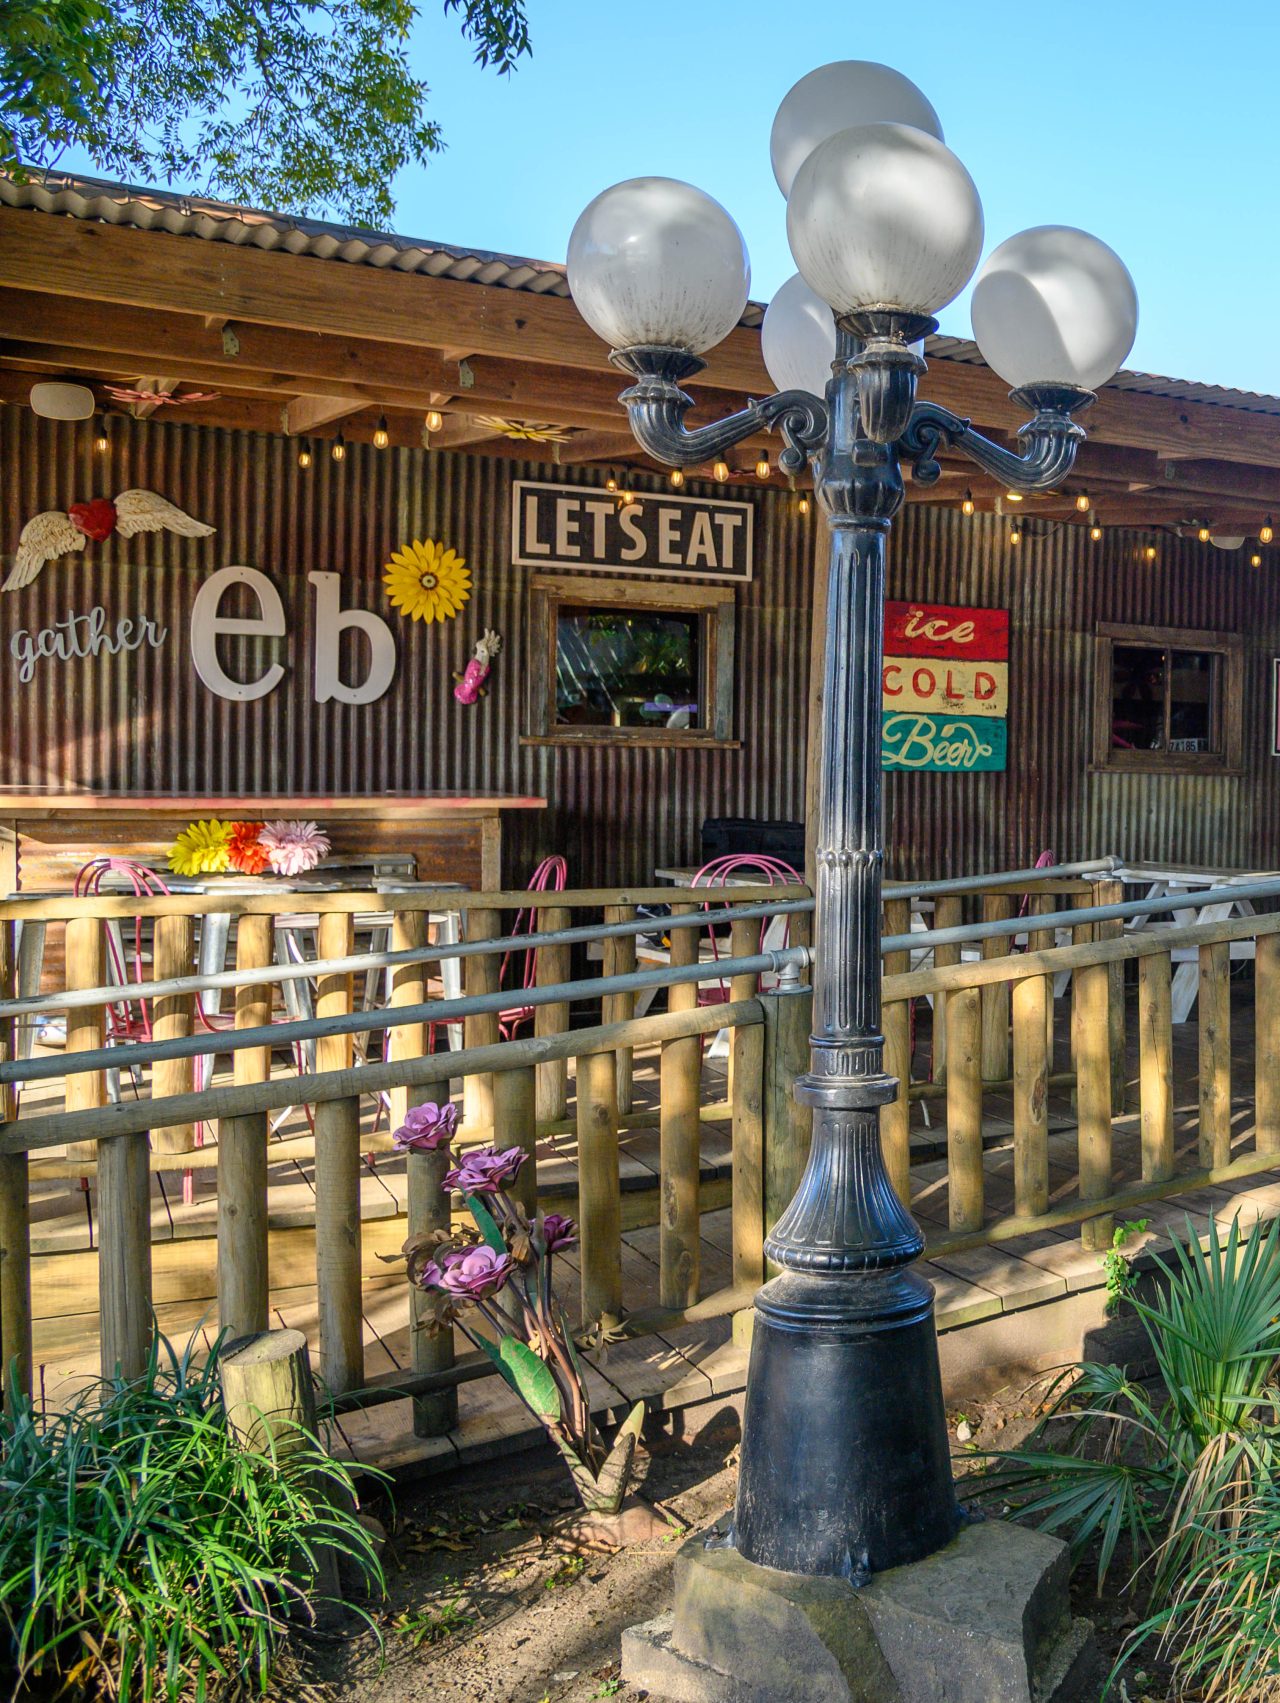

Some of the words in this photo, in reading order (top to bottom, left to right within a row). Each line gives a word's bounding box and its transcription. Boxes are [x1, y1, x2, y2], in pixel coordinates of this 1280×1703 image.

[525, 495, 648, 561] LET'S
[658, 507, 742, 569] EAT
[10, 606, 168, 683] gather
[190, 565, 397, 705] eb
[905, 610, 976, 644] ice
[882, 665, 998, 700] COLD
[881, 714, 993, 768] Beer
